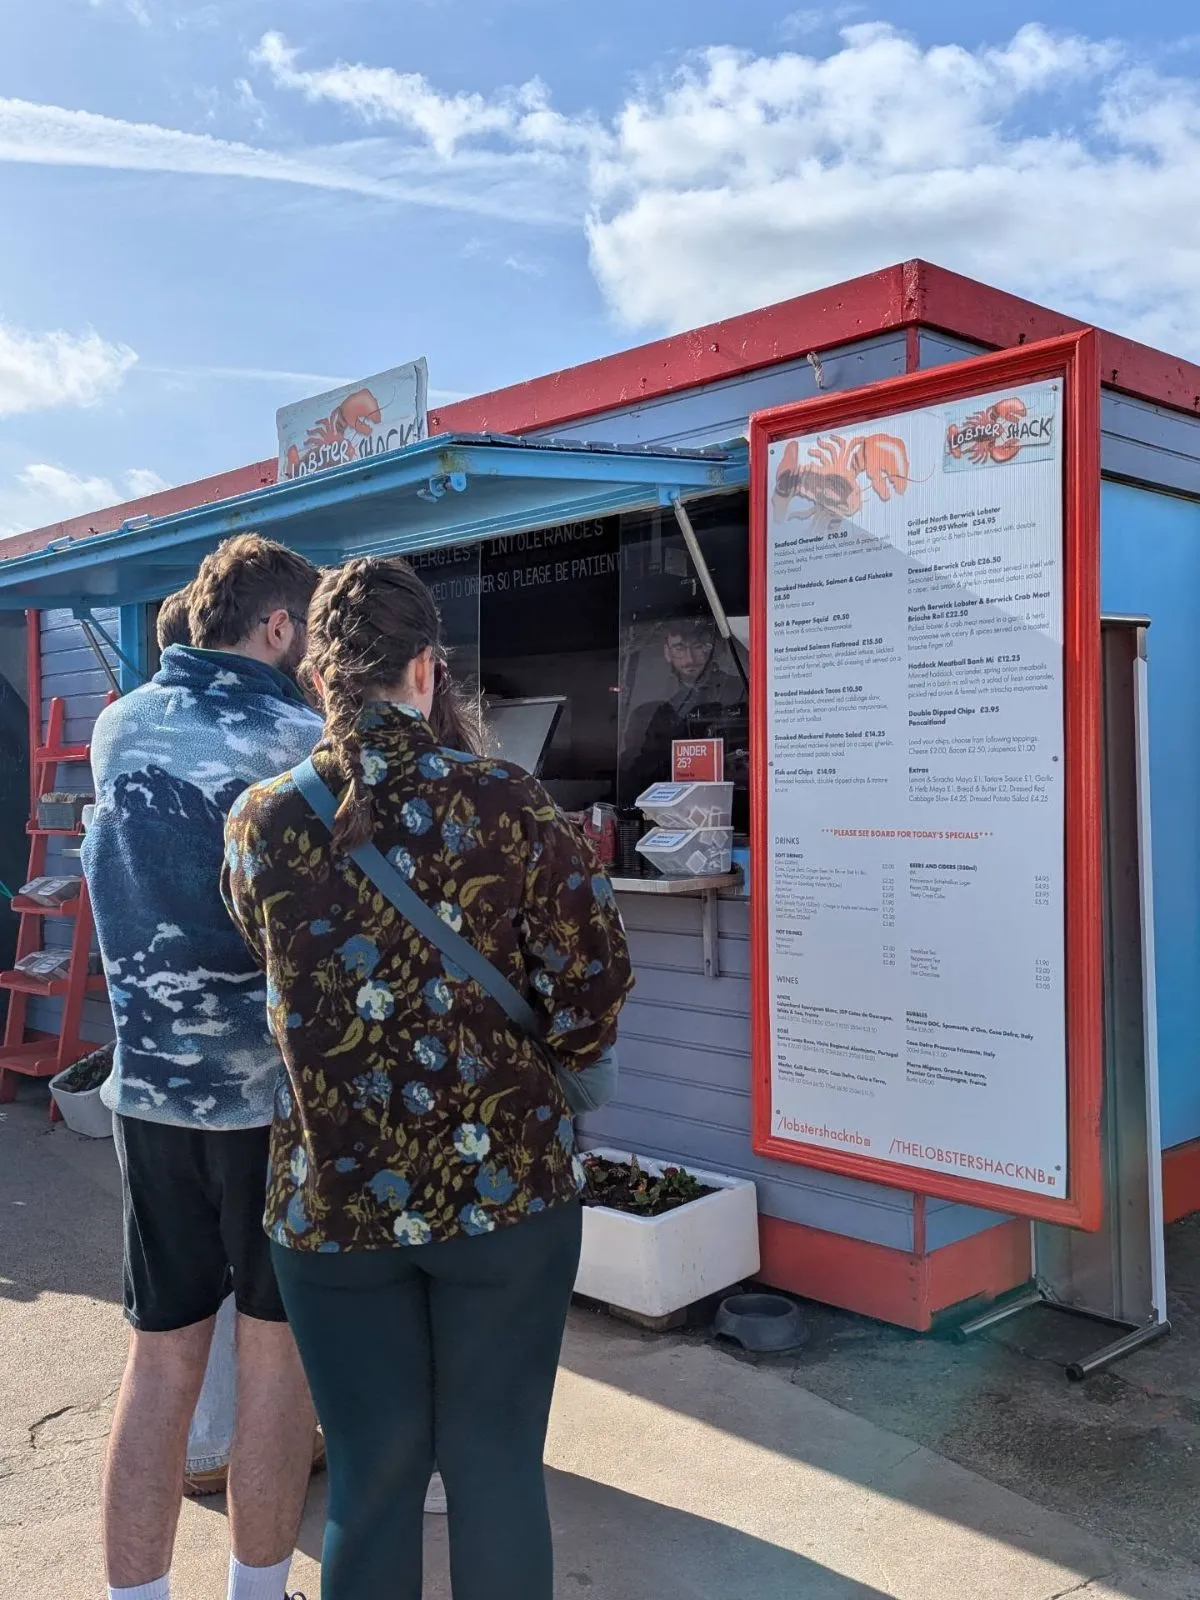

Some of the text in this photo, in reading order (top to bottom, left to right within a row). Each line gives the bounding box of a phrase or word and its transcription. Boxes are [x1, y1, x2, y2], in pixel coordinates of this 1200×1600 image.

[951, 417, 1051, 449] LOBSTER SHACK
[359, 423, 414, 458] SHACK
[907, 506, 1001, 526] Grilled North Berwick Lobster
[907, 516, 996, 536] Half £29.95 Whole £54.95
[412, 522, 604, 568] LERGIES INTOLERANCES
[774, 539, 797, 548] Seafood
[827, 531, 848, 540] £10.50
[907, 555, 1001, 574] Dressed Berwick Crab £26.50
[449, 580, 462, 599] TO
[464, 574, 495, 596] ORDER
[497, 571, 510, 589] SO
[513, 564, 552, 588] PLEASE
[555, 562, 568, 581] BE
[773, 583, 796, 592] Smoked
[797, 580, 824, 590] Haddock,
[825, 576, 847, 585] Salmon
[854, 574, 866, 582] Cod
[867, 570, 893, 580] Fishcake
[907, 604, 926, 612] North
[927, 601, 952, 610] Berwick
[953, 598, 977, 607] Lobster
[985, 594, 1012, 604] Berwick
[1014, 592, 1031, 601] Crab
[1032, 590, 1050, 599] Meat
[791, 617, 811, 626] Pepper
[812, 615, 829, 624] Squid
[832, 613, 850, 621] £9.50
[907, 613, 931, 622] Brioche
[945, 609, 968, 618] £22.50
[785, 644, 808, 652] Smoked
[808, 642, 830, 650] Salmon
[831, 639, 860, 648] Flatbread
[861, 637, 883, 645] £15.50
[907, 661, 936, 669] Haddock
[937, 658, 966, 667] Meatball
[966, 657, 984, 665] Banh
[997, 654, 1020, 662] £12.25
[773, 689, 798, 697] Breaded
[932, 708, 955, 716] Dipped
[956, 707, 975, 715] Chips
[979, 705, 1000, 713] £3.95
[985, 735, 1011, 744] following
[676, 745, 707, 757] UNDER
[676, 757, 692, 769] 25?
[797, 768, 813, 776] Chips
[955, 775, 972, 783] Mayo
[857, 829, 869, 837] SEE
[870, 829, 895, 837] BOARD
[896, 830, 911, 838] FOR
[912, 830, 943, 839] TODAY'S
[776, 974, 799, 984] WINES
[1020, 1033, 1033, 1041] Italy
[982, 1050, 995, 1058] Italy
[969, 1079, 987, 1087] France
[777, 1116, 863, 1145] /lobstershacknb
[889, 1138, 1046, 1183] /THELOBSTERSHACKNB
